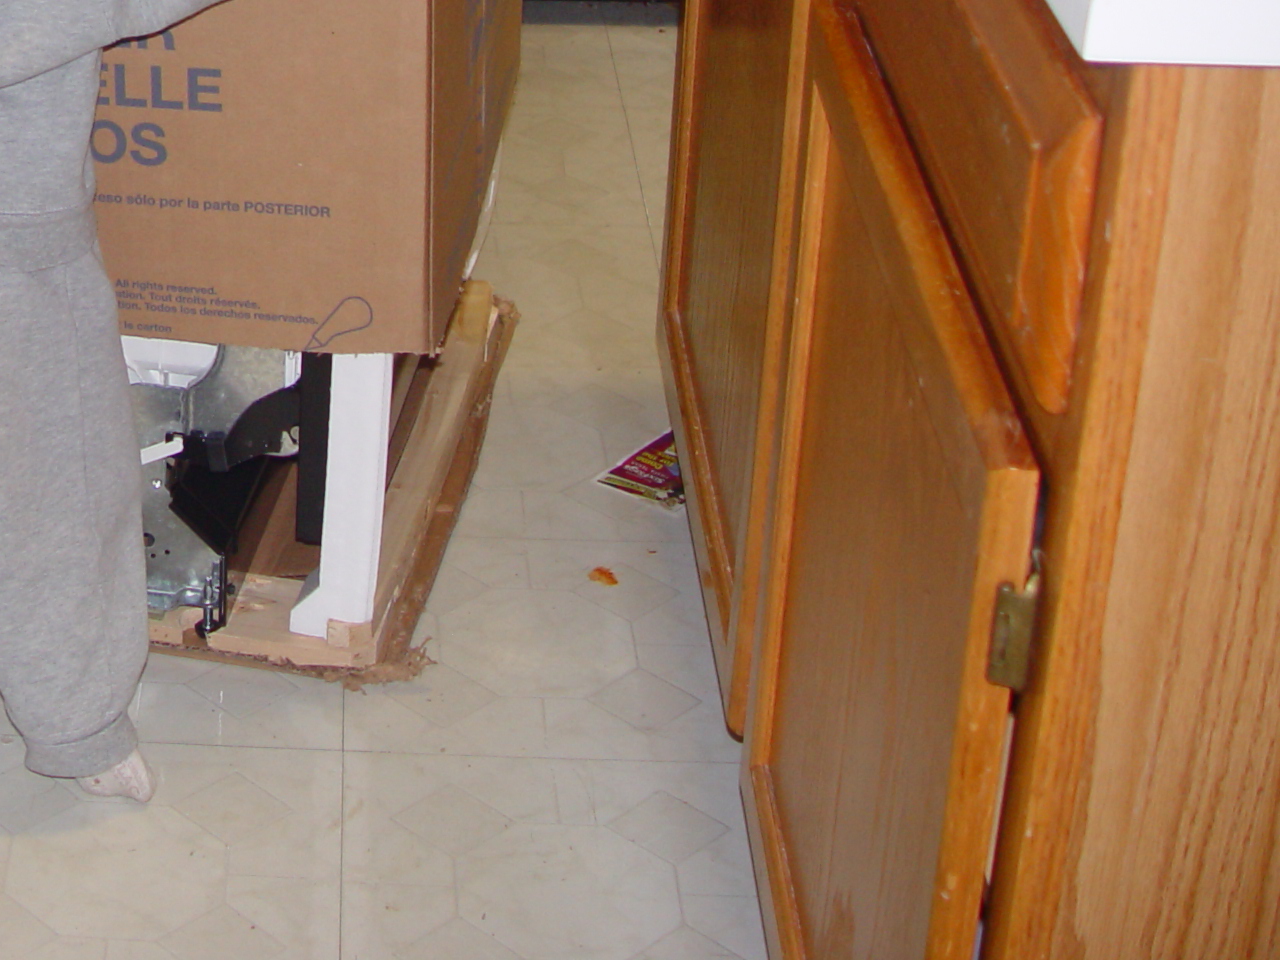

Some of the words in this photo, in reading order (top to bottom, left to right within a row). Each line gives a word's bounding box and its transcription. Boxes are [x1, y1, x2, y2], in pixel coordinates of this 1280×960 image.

[126, 193, 155, 206] sólo
[159, 197, 182, 209] por
[188, 196, 199, 209] la
[203, 200, 240, 213] parte
[244, 201, 330, 218] POSTERIOR
[116, 279, 129, 288] All
[132, 281, 163, 291] rights
[167, 284, 218, 296] reserved.
[149, 292, 172, 302] Tout
[175, 295, 207, 306] droits
[144, 302, 177, 313] Todos
[180, 305, 197, 316] los
[200, 307, 251, 320] derechos
[254, 312, 319, 325] reservados.
[137, 323, 173, 333] carton
